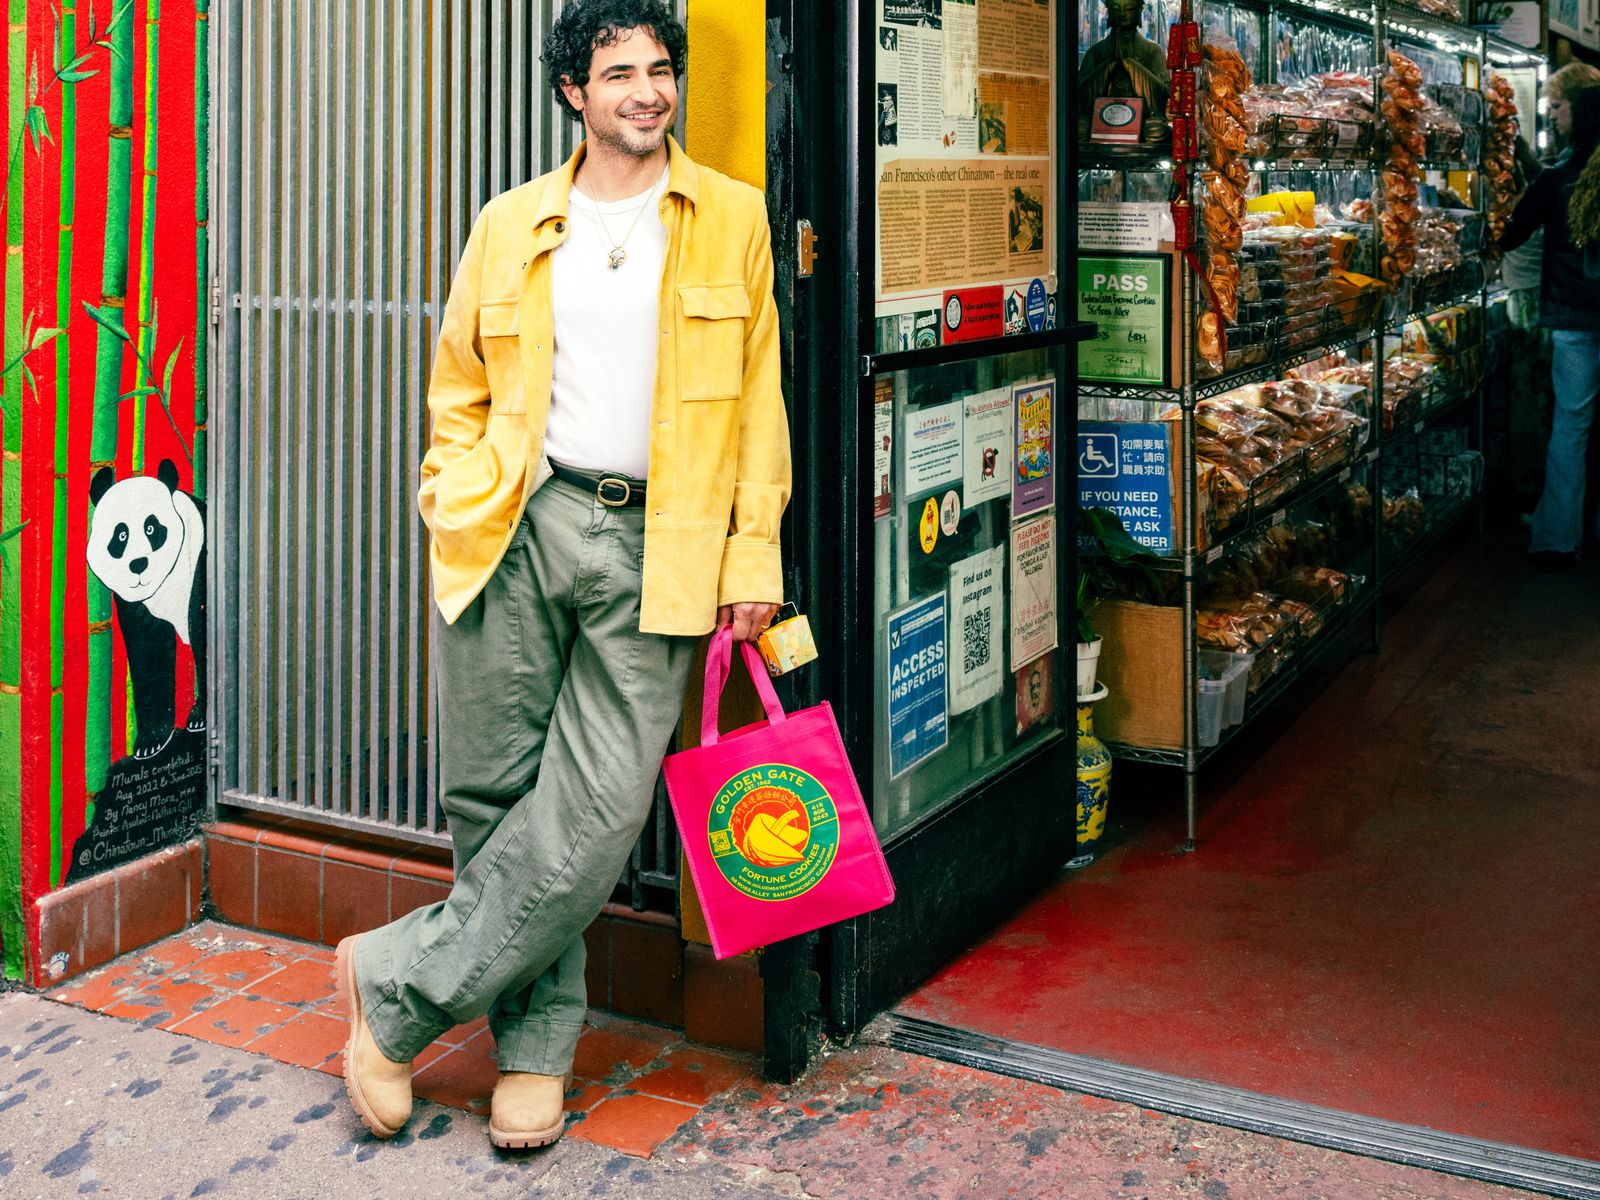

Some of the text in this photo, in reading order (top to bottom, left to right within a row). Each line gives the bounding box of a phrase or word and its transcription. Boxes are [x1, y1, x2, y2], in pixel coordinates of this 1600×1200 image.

[895, 168, 935, 183] Francisco's
[936, 166, 956, 182] other
[958, 165, 995, 181] Chinatown
[1004, 166, 1014, 180] the
[1016, 165, 1028, 180] real
[1028, 169, 1040, 179] one
[1093, 273, 1148, 292] PASS
[1121, 440, 1164, 450] 如需要幫
[1122, 465, 1165, 476] 職員求助
[1081, 491, 1159, 502] IF YOU NEED
[1017, 520, 1051, 541] PLEASE DO NOT
[1133, 521, 1160, 532] ASK
[1019, 531, 1050, 550] FEED PIGEONS
[963, 568, 992, 588] Find us on
[962, 584, 993, 604] Instagram
[892, 640, 944, 686] ACCESS
[891, 662, 944, 703] INSPECTED
[112, 765, 149, 788] Murals
[136, 780, 159, 796] 2022
[715, 769, 806, 814] GOLDEN GATE
[104, 808, 118, 822] By
[737, 881, 752, 892] ROSS
[751, 888, 770, 897] ALLEY
[785, 877, 815, 895] FRANCISCO
[816, 842, 835, 877] CALIFORNIA
[741, 843, 820, 883] FORTUNE COOKIES
